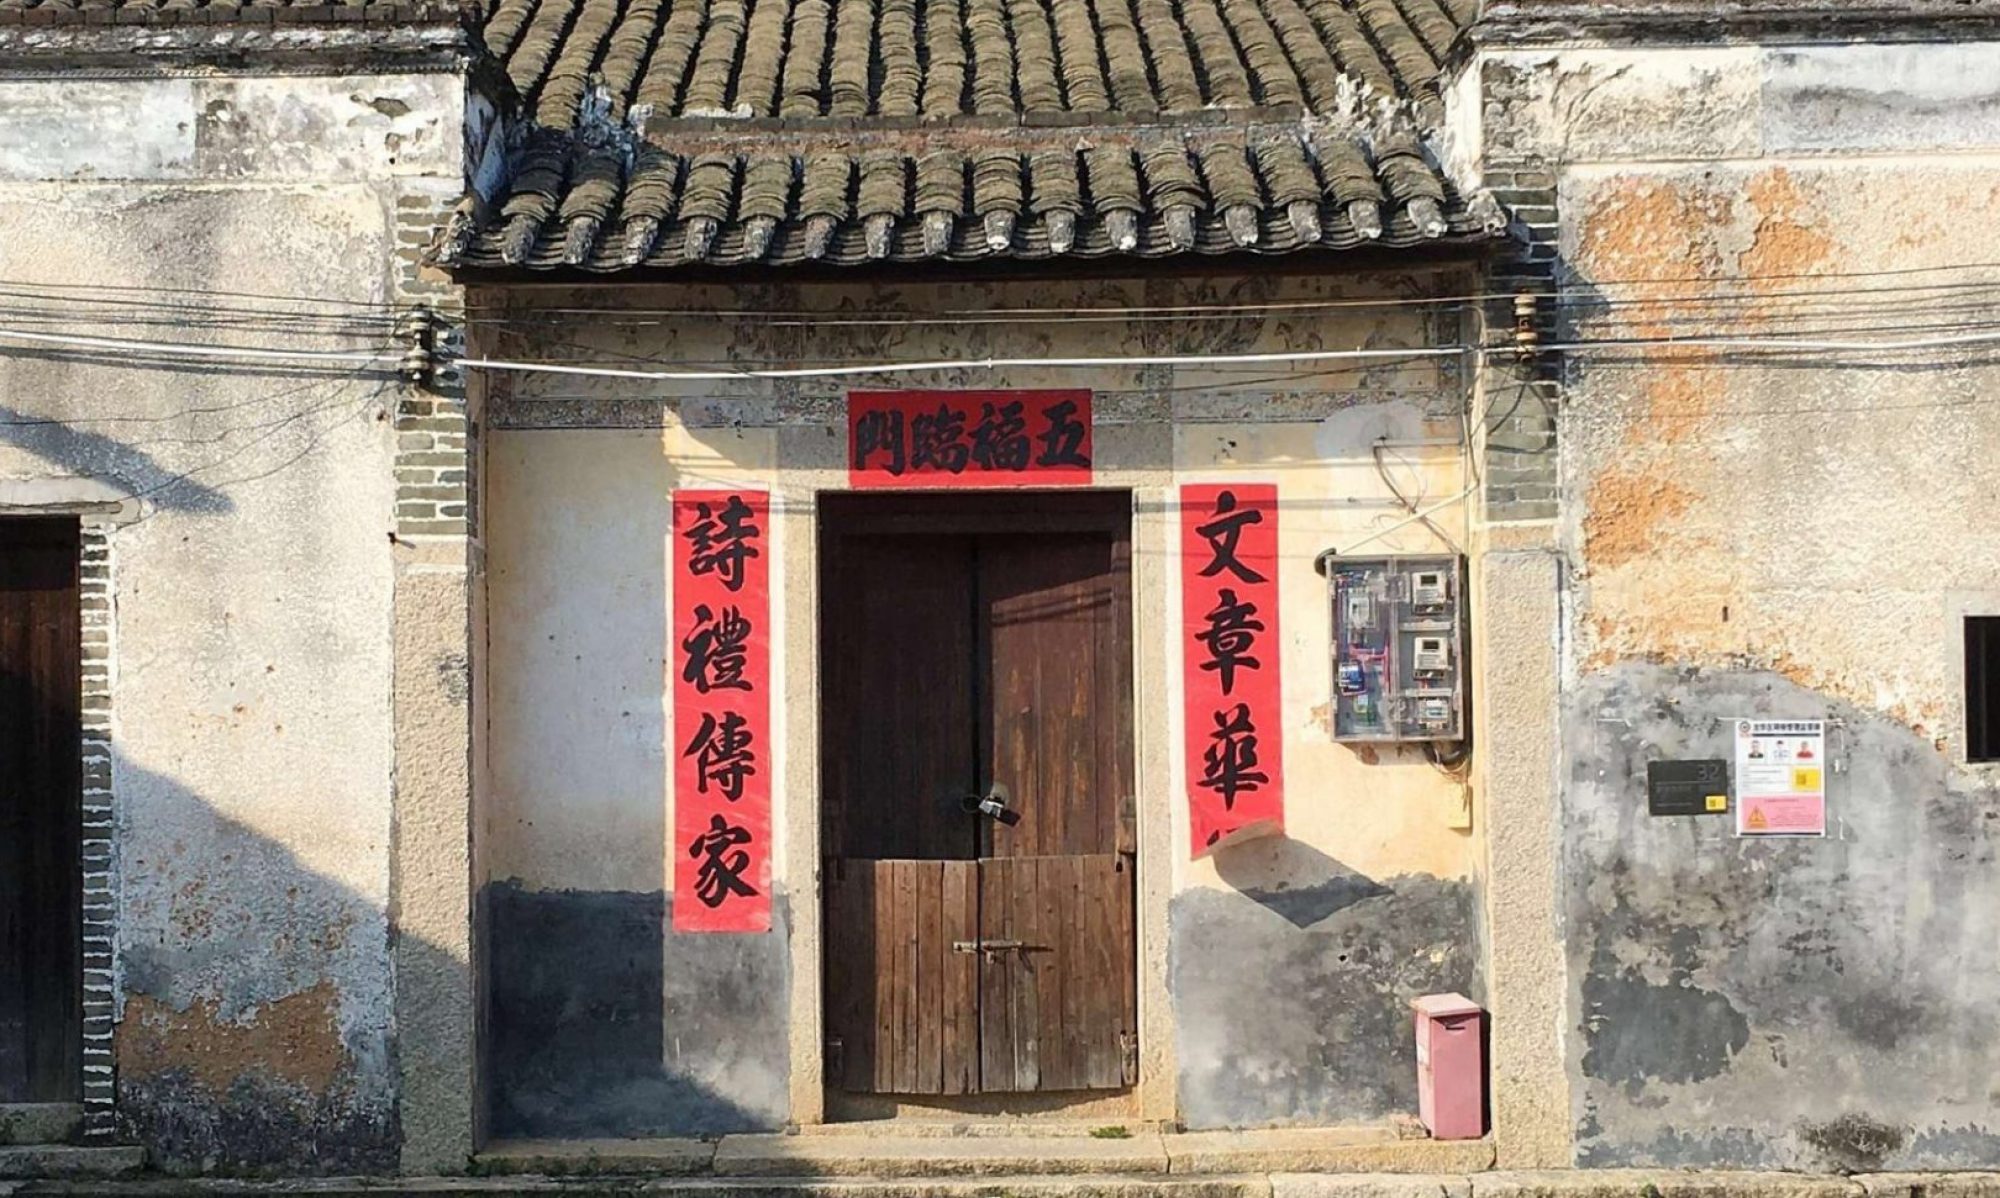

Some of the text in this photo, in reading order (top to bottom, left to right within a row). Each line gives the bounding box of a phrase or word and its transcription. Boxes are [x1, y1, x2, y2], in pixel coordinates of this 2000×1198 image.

[855, 400, 1092, 477] 五福臨門
[682, 495, 761, 908] 詩禮傳家
[1194, 490, 1270, 847] 文章華
